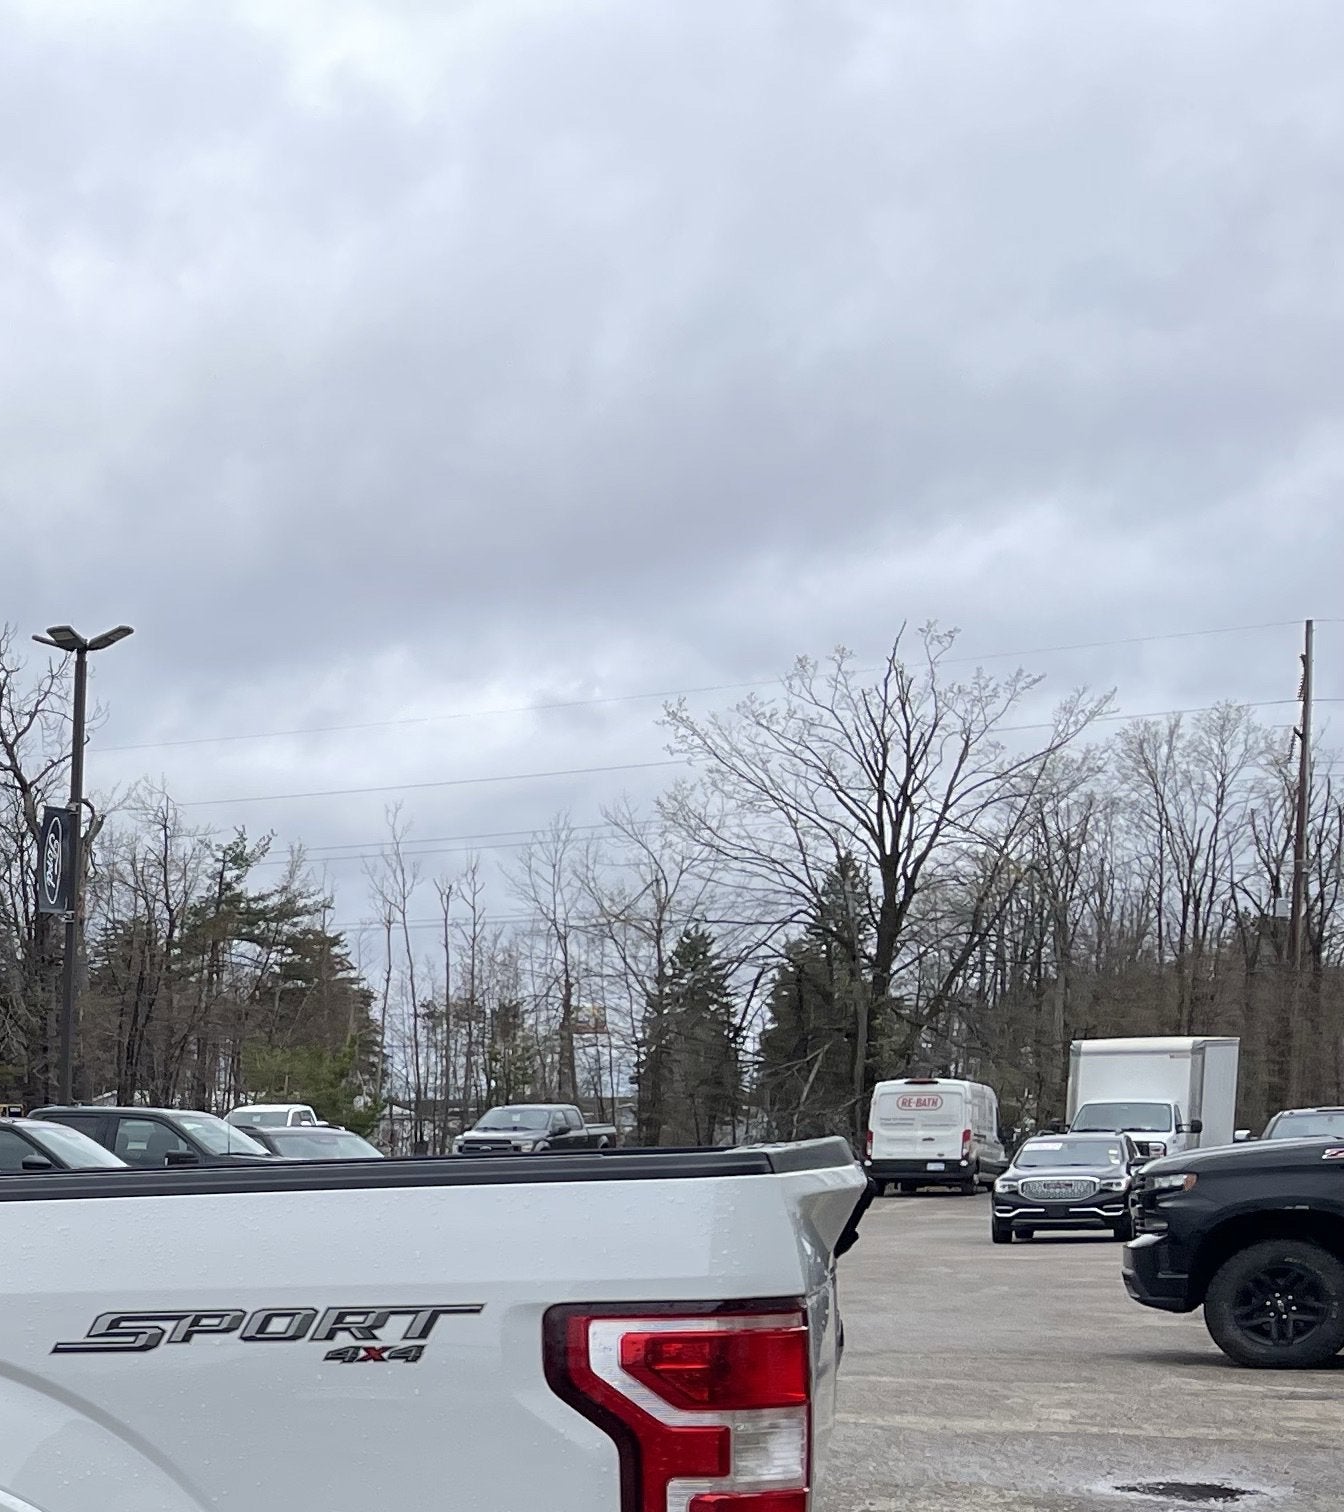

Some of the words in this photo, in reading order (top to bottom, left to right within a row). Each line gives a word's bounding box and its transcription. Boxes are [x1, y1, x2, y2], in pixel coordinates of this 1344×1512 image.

[47, 833, 60, 888] Ford
[900, 1097, 939, 1108] RE-BATH
[50, 1304, 485, 1354] SPORT
